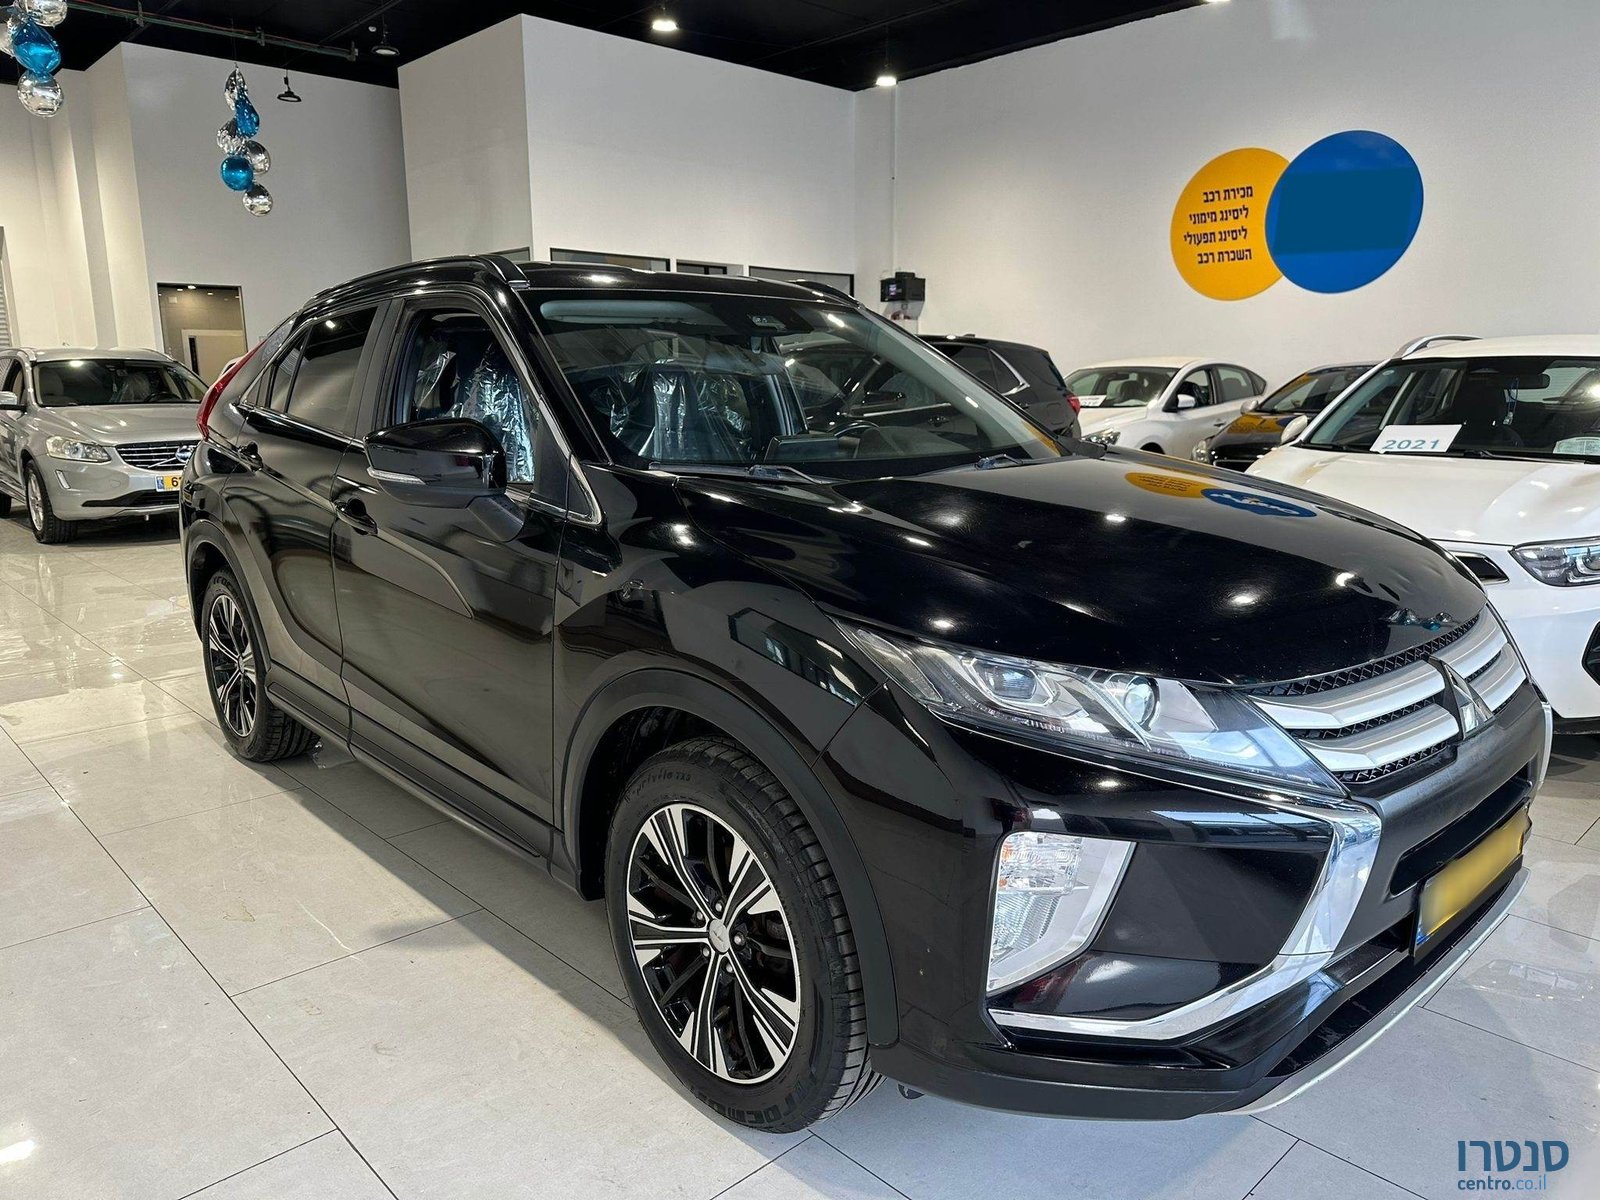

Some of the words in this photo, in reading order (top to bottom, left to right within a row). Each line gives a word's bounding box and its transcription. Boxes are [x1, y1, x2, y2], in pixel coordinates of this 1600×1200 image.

[1202, 190, 1221, 203] רכב
[1223, 185, 1253, 201] מכירת
[1188, 211, 1217, 225] מימוני
[1219, 204, 1249, 222] ליסינג
[1183, 231, 1217, 247] תפעולי
[1218, 225, 1248, 242] ליסינג
[1196, 252, 1215, 265] רכב
[1217, 248, 1252, 263] השכרת
[1381, 439, 1441, 450] 2021
